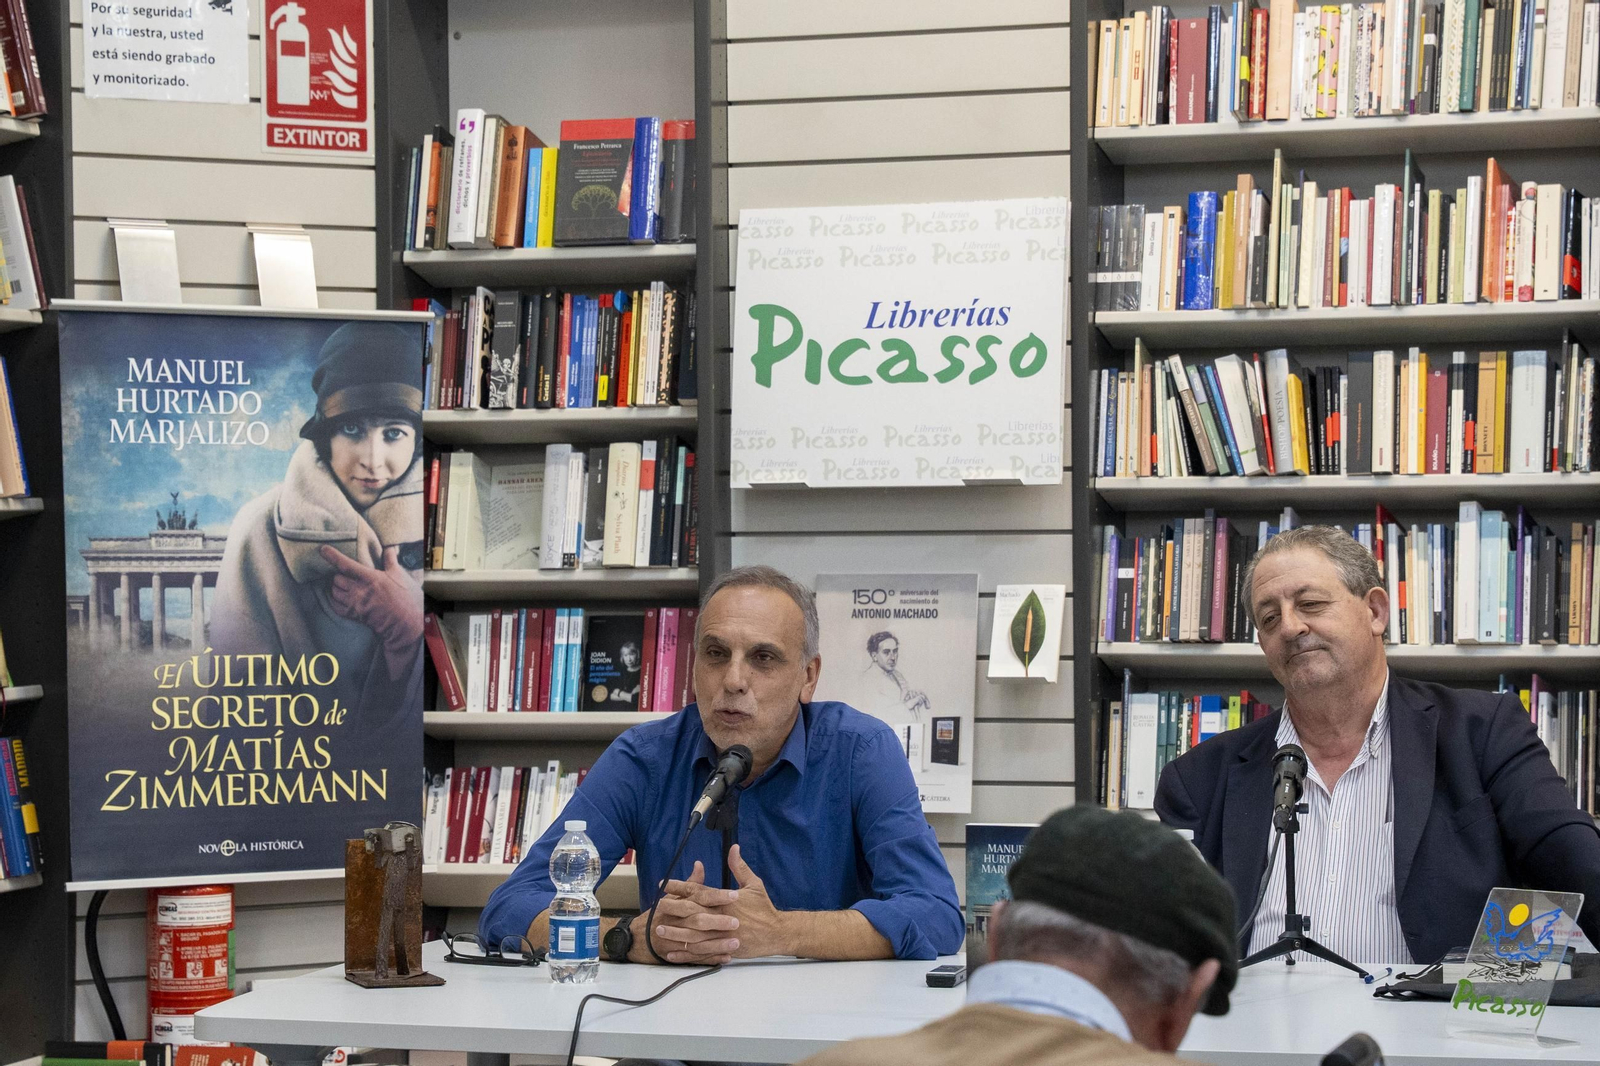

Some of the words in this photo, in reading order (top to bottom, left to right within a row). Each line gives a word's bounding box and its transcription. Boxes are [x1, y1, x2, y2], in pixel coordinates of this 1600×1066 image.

[91, 3, 111, 13] Por
[116, 6, 128, 15] su
[133, 6, 192, 19] seguridad
[92, 26, 98, 37] y
[102, 24, 113, 35] la
[117, 27, 166, 41] nuestra,
[170, 29, 204, 40] usted
[92, 49, 118, 60] está
[122, 51, 162, 62] siendo
[165, 53, 215, 65] grabado
[93, 74, 100, 85] y
[104, 73, 189, 87] monitorizado.
[273, 127, 360, 148] EXTINTOR
[455, 179, 463, 215] diccionario
[748, 217, 785, 226] Librerías
[839, 213, 876, 223] Librerías
[932, 211, 970, 219] Librerías
[809, 215, 885, 236] Picasso
[901, 212, 979, 234] Picasso
[748, 248, 824, 270] Picasso
[839, 246, 917, 267] Picasso
[932, 243, 1010, 265] Picasso
[777, 247, 815, 256] Librerías
[869, 244, 907, 253] Librerías
[962, 241, 1000, 250] Librerías
[863, 298, 1011, 330] Librerías
[748, 303, 1047, 388] Picasso
[127, 357, 251, 386] MANUEL
[116, 388, 262, 415] HURTADO
[1275, 390, 1286, 424] POESÍA
[109, 418, 270, 451] MARJALIZO
[791, 427, 868, 449] Picasso
[883, 425, 962, 448] Picasso
[977, 424, 1056, 446] Picasso
[820, 426, 858, 434] Librerías
[914, 425, 952, 433] Librerías
[1008, 421, 1053, 431] Librerías
[1278, 425, 1289, 460] BISHOP
[732, 460, 807, 481] Picasso
[822, 459, 899, 481] Picasso
[915, 457, 994, 480] Picasso
[760, 459, 798, 468] Librerías
[852, 458, 890, 467] Librerías
[946, 456, 985, 465] Librerías
[526, 477, 543, 485] AREN
[544, 535, 558, 564] JOYCE
[851, 608, 891, 619] ANTONIO
[895, 608, 938, 619] MACHADO
[154, 660, 192, 689] El
[191, 647, 339, 688] ÚLTIMO
[151, 693, 319, 731] SECRETO
[324, 699, 347, 726] de
[12, 739, 30, 788] MADRID
[164, 730, 332, 776] MATÍAS
[100, 768, 388, 812] ZIMMERMANN
[431, 790, 439, 815] Manguel
[496, 802, 506, 836] NAVARRO
[251, 838, 304, 852] HISTÓRICA
[493, 837, 502, 858] JULIA
[988, 844, 1025, 853] MANUE
[1452, 978, 1544, 1017] Picasso
